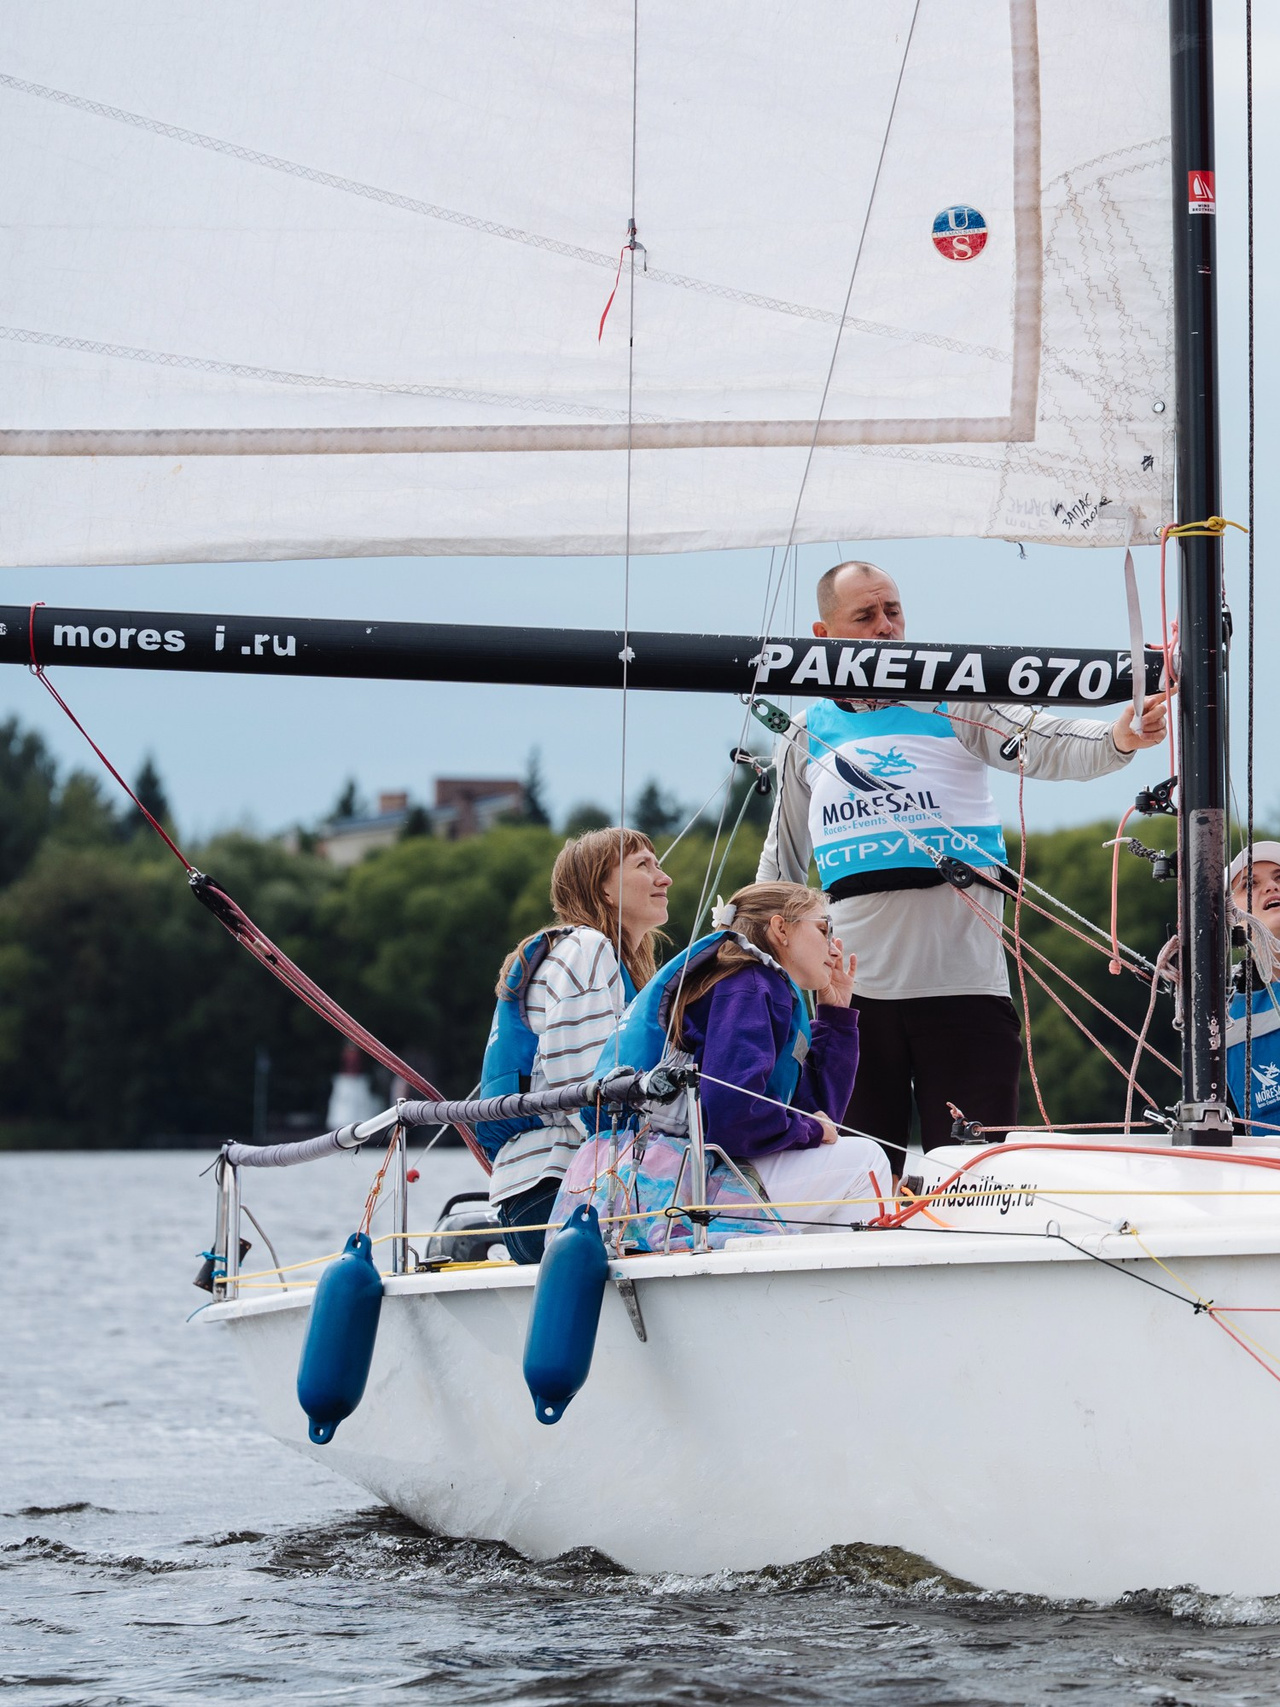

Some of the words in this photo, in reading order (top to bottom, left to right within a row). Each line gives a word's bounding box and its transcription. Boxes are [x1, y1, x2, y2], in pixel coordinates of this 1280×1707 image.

[947, 208, 969, 230] U
[952, 236, 972, 259] S
[1008, 656, 1113, 700] 670
[823, 791, 941, 826] MORESAIL
